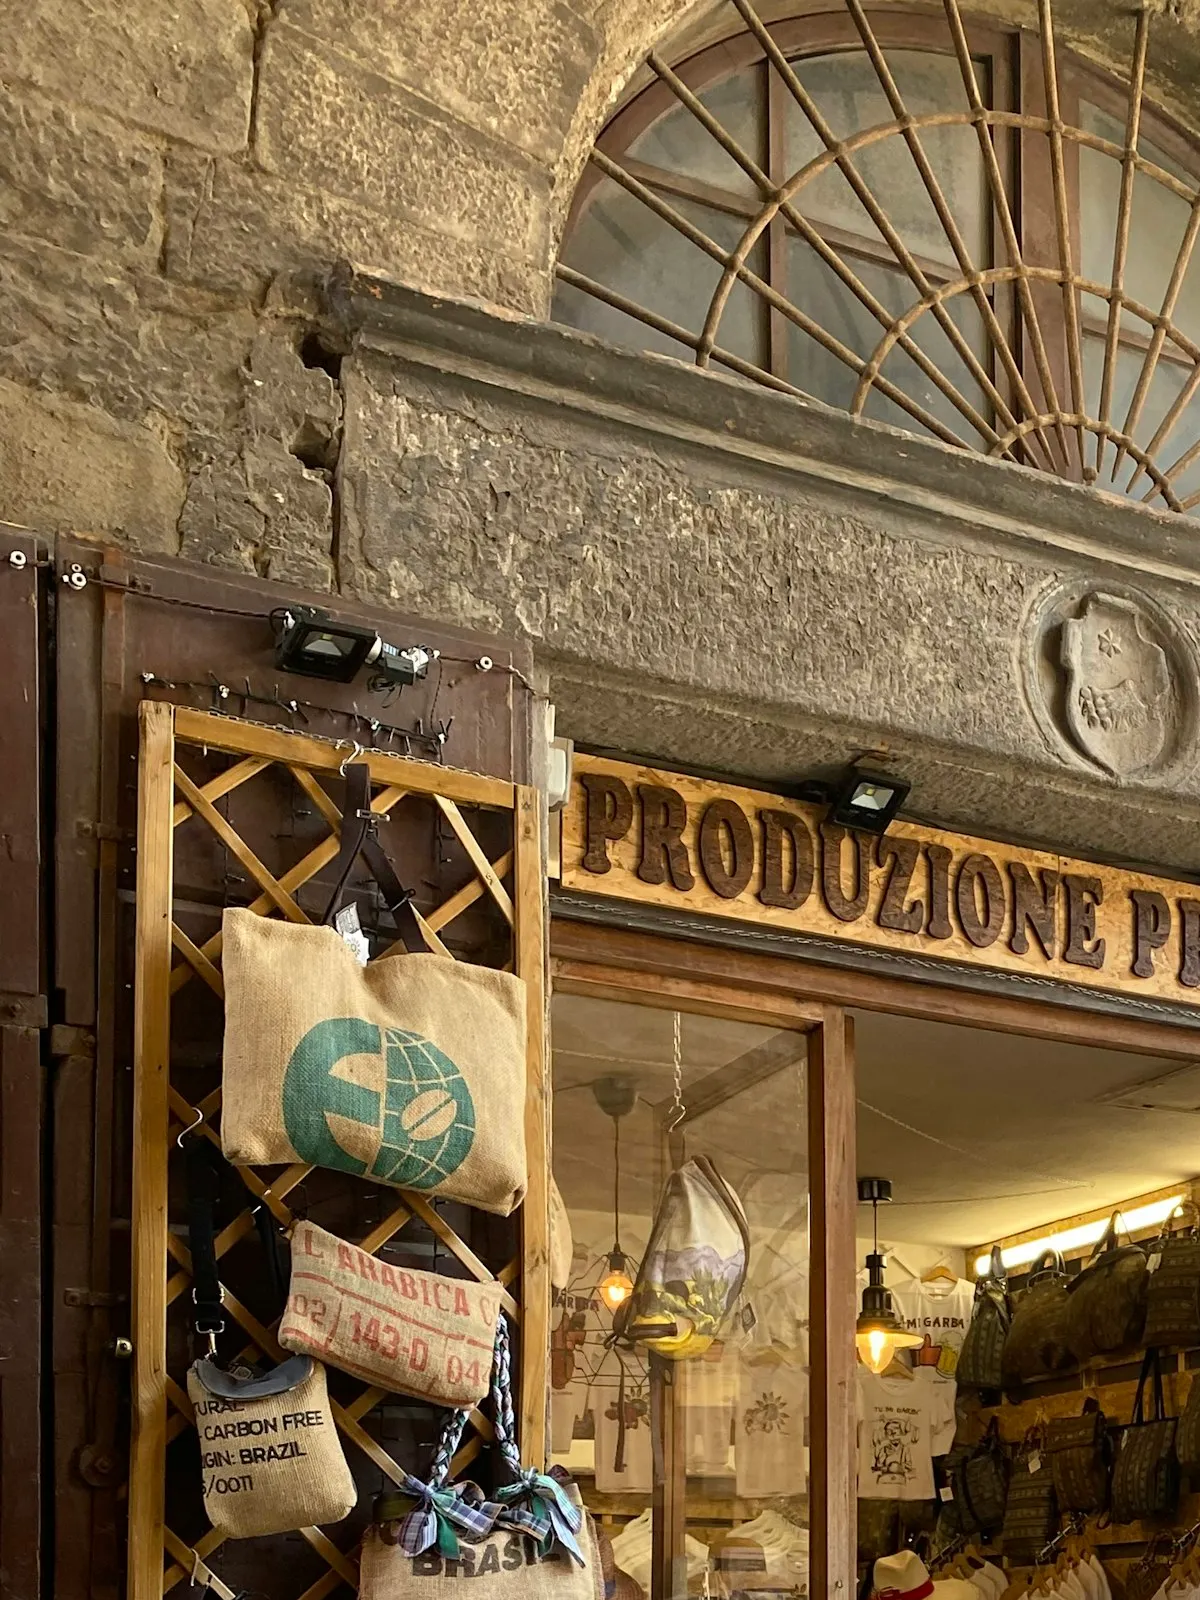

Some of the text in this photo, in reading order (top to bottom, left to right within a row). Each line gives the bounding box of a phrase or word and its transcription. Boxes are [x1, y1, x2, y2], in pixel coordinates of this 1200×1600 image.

[579, 771, 1107, 970] PRODUZIONE
[336, 1243, 471, 1317] ARABICA
[204, 1410, 324, 1441] CARBON FREE
[239, 1441, 308, 1465] BRAZIL
